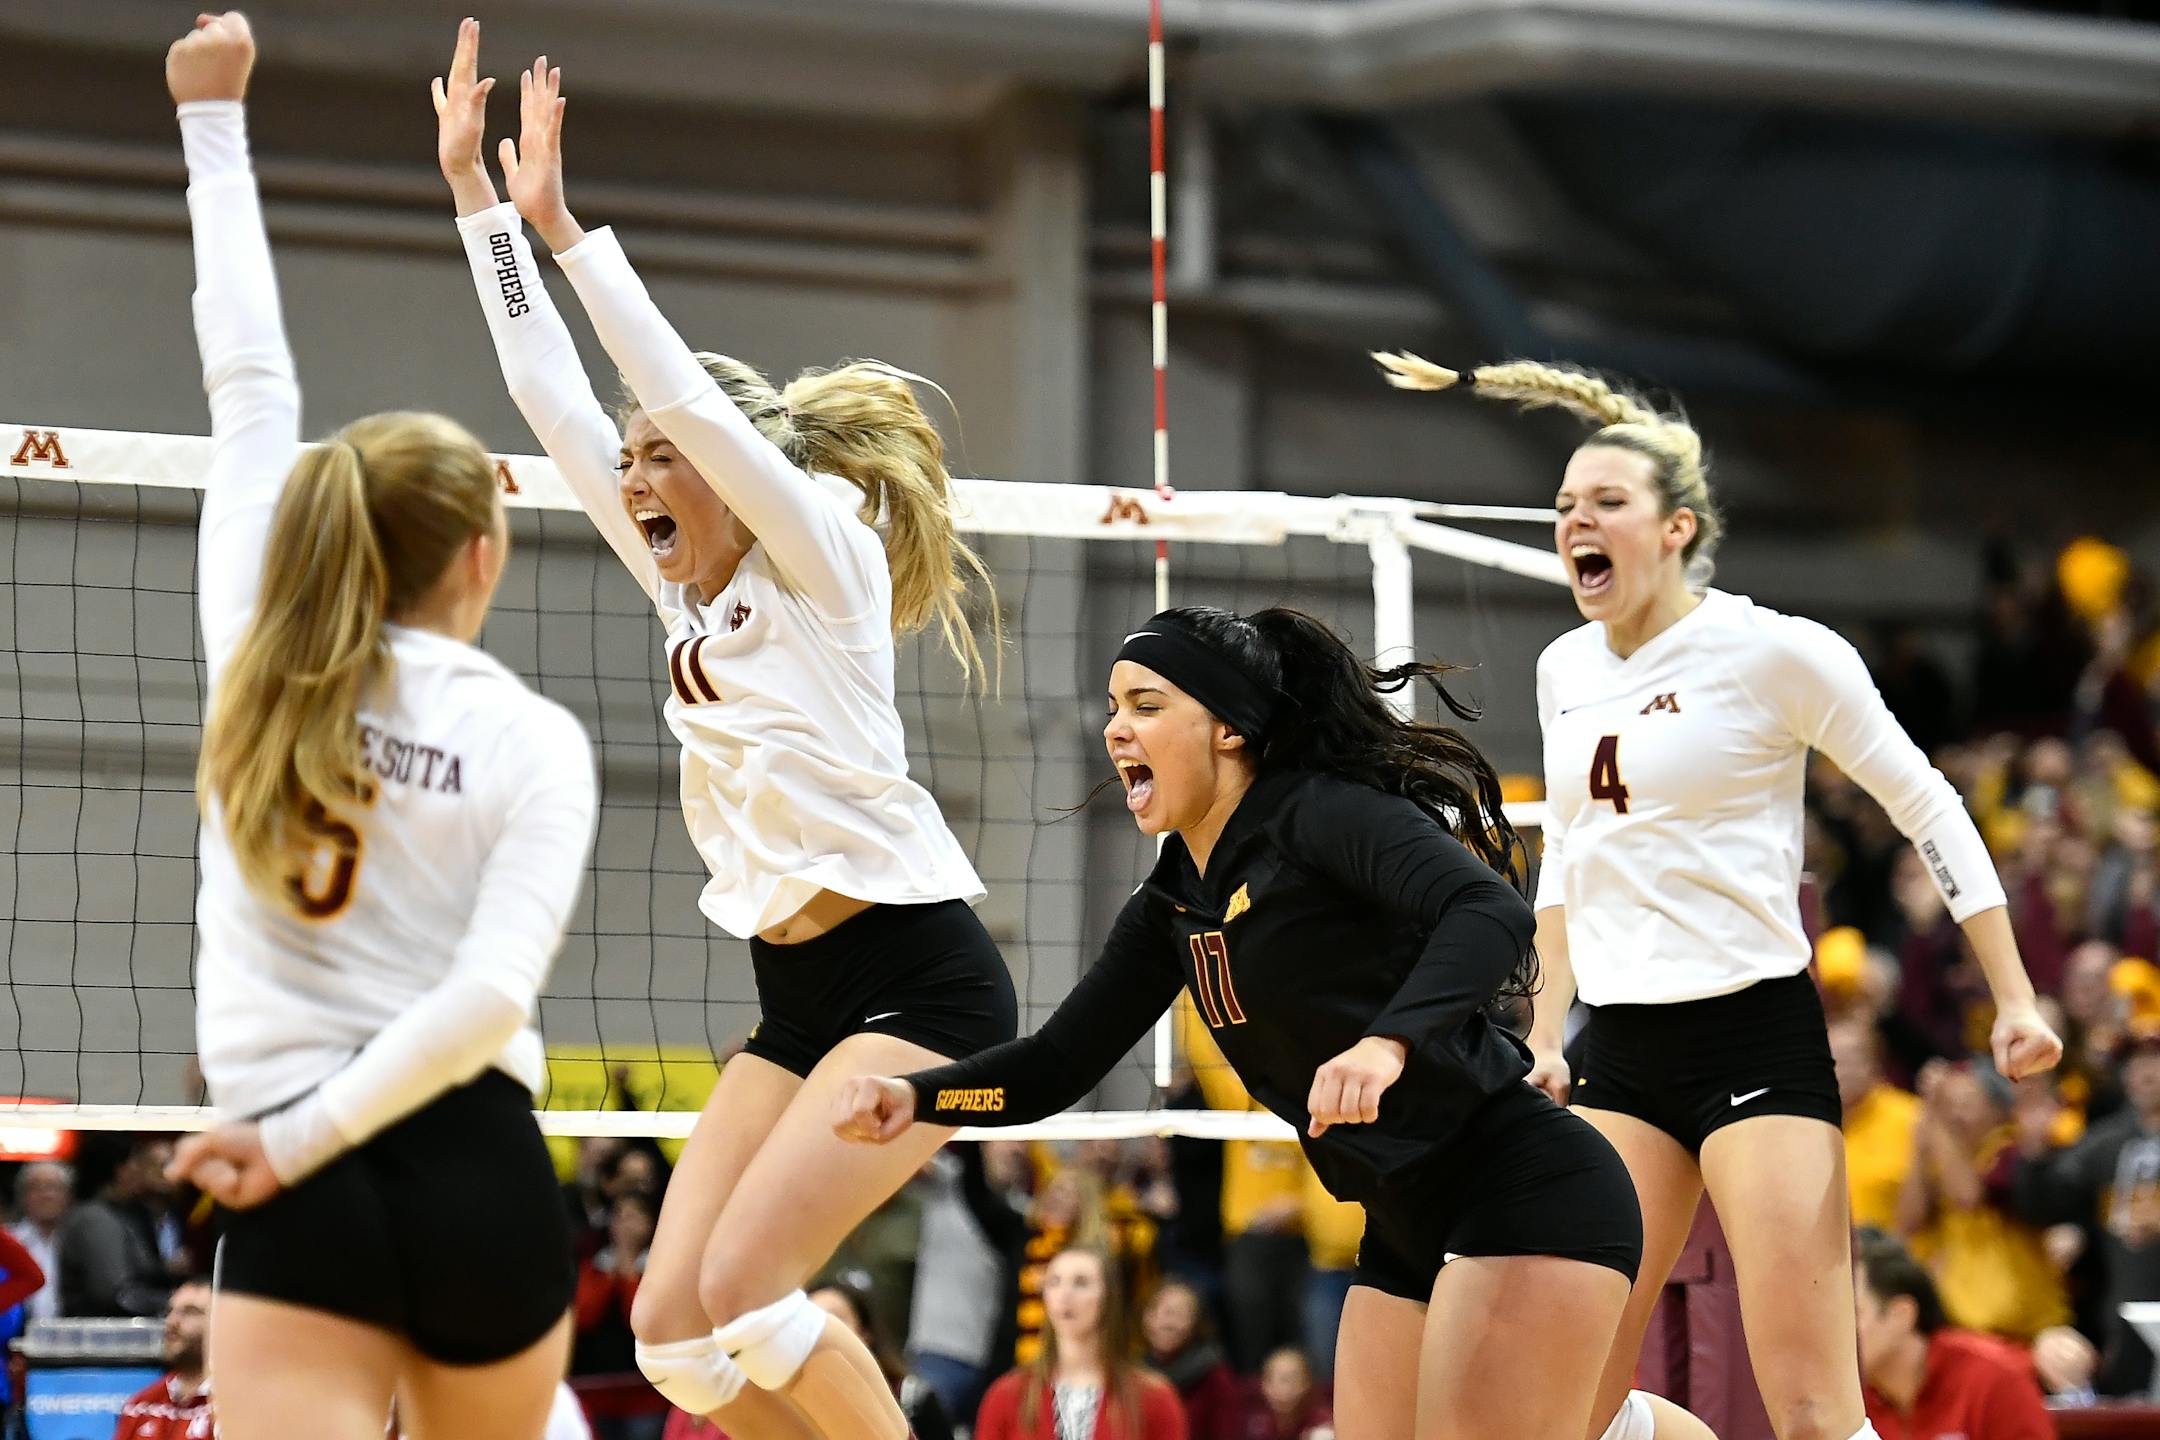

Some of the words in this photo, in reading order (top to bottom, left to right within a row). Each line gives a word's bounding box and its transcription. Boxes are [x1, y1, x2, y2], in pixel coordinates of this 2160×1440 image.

[487, 232, 530, 318] GOPHERS
[10, 430, 69, 468] M
[670, 634, 725, 707] 11
[358, 723, 462, 794] ESOTA
[1588, 733, 1630, 815] 4
[1189, 931, 1247, 1029] 17
[935, 1087, 1004, 1111] GOPHERS
